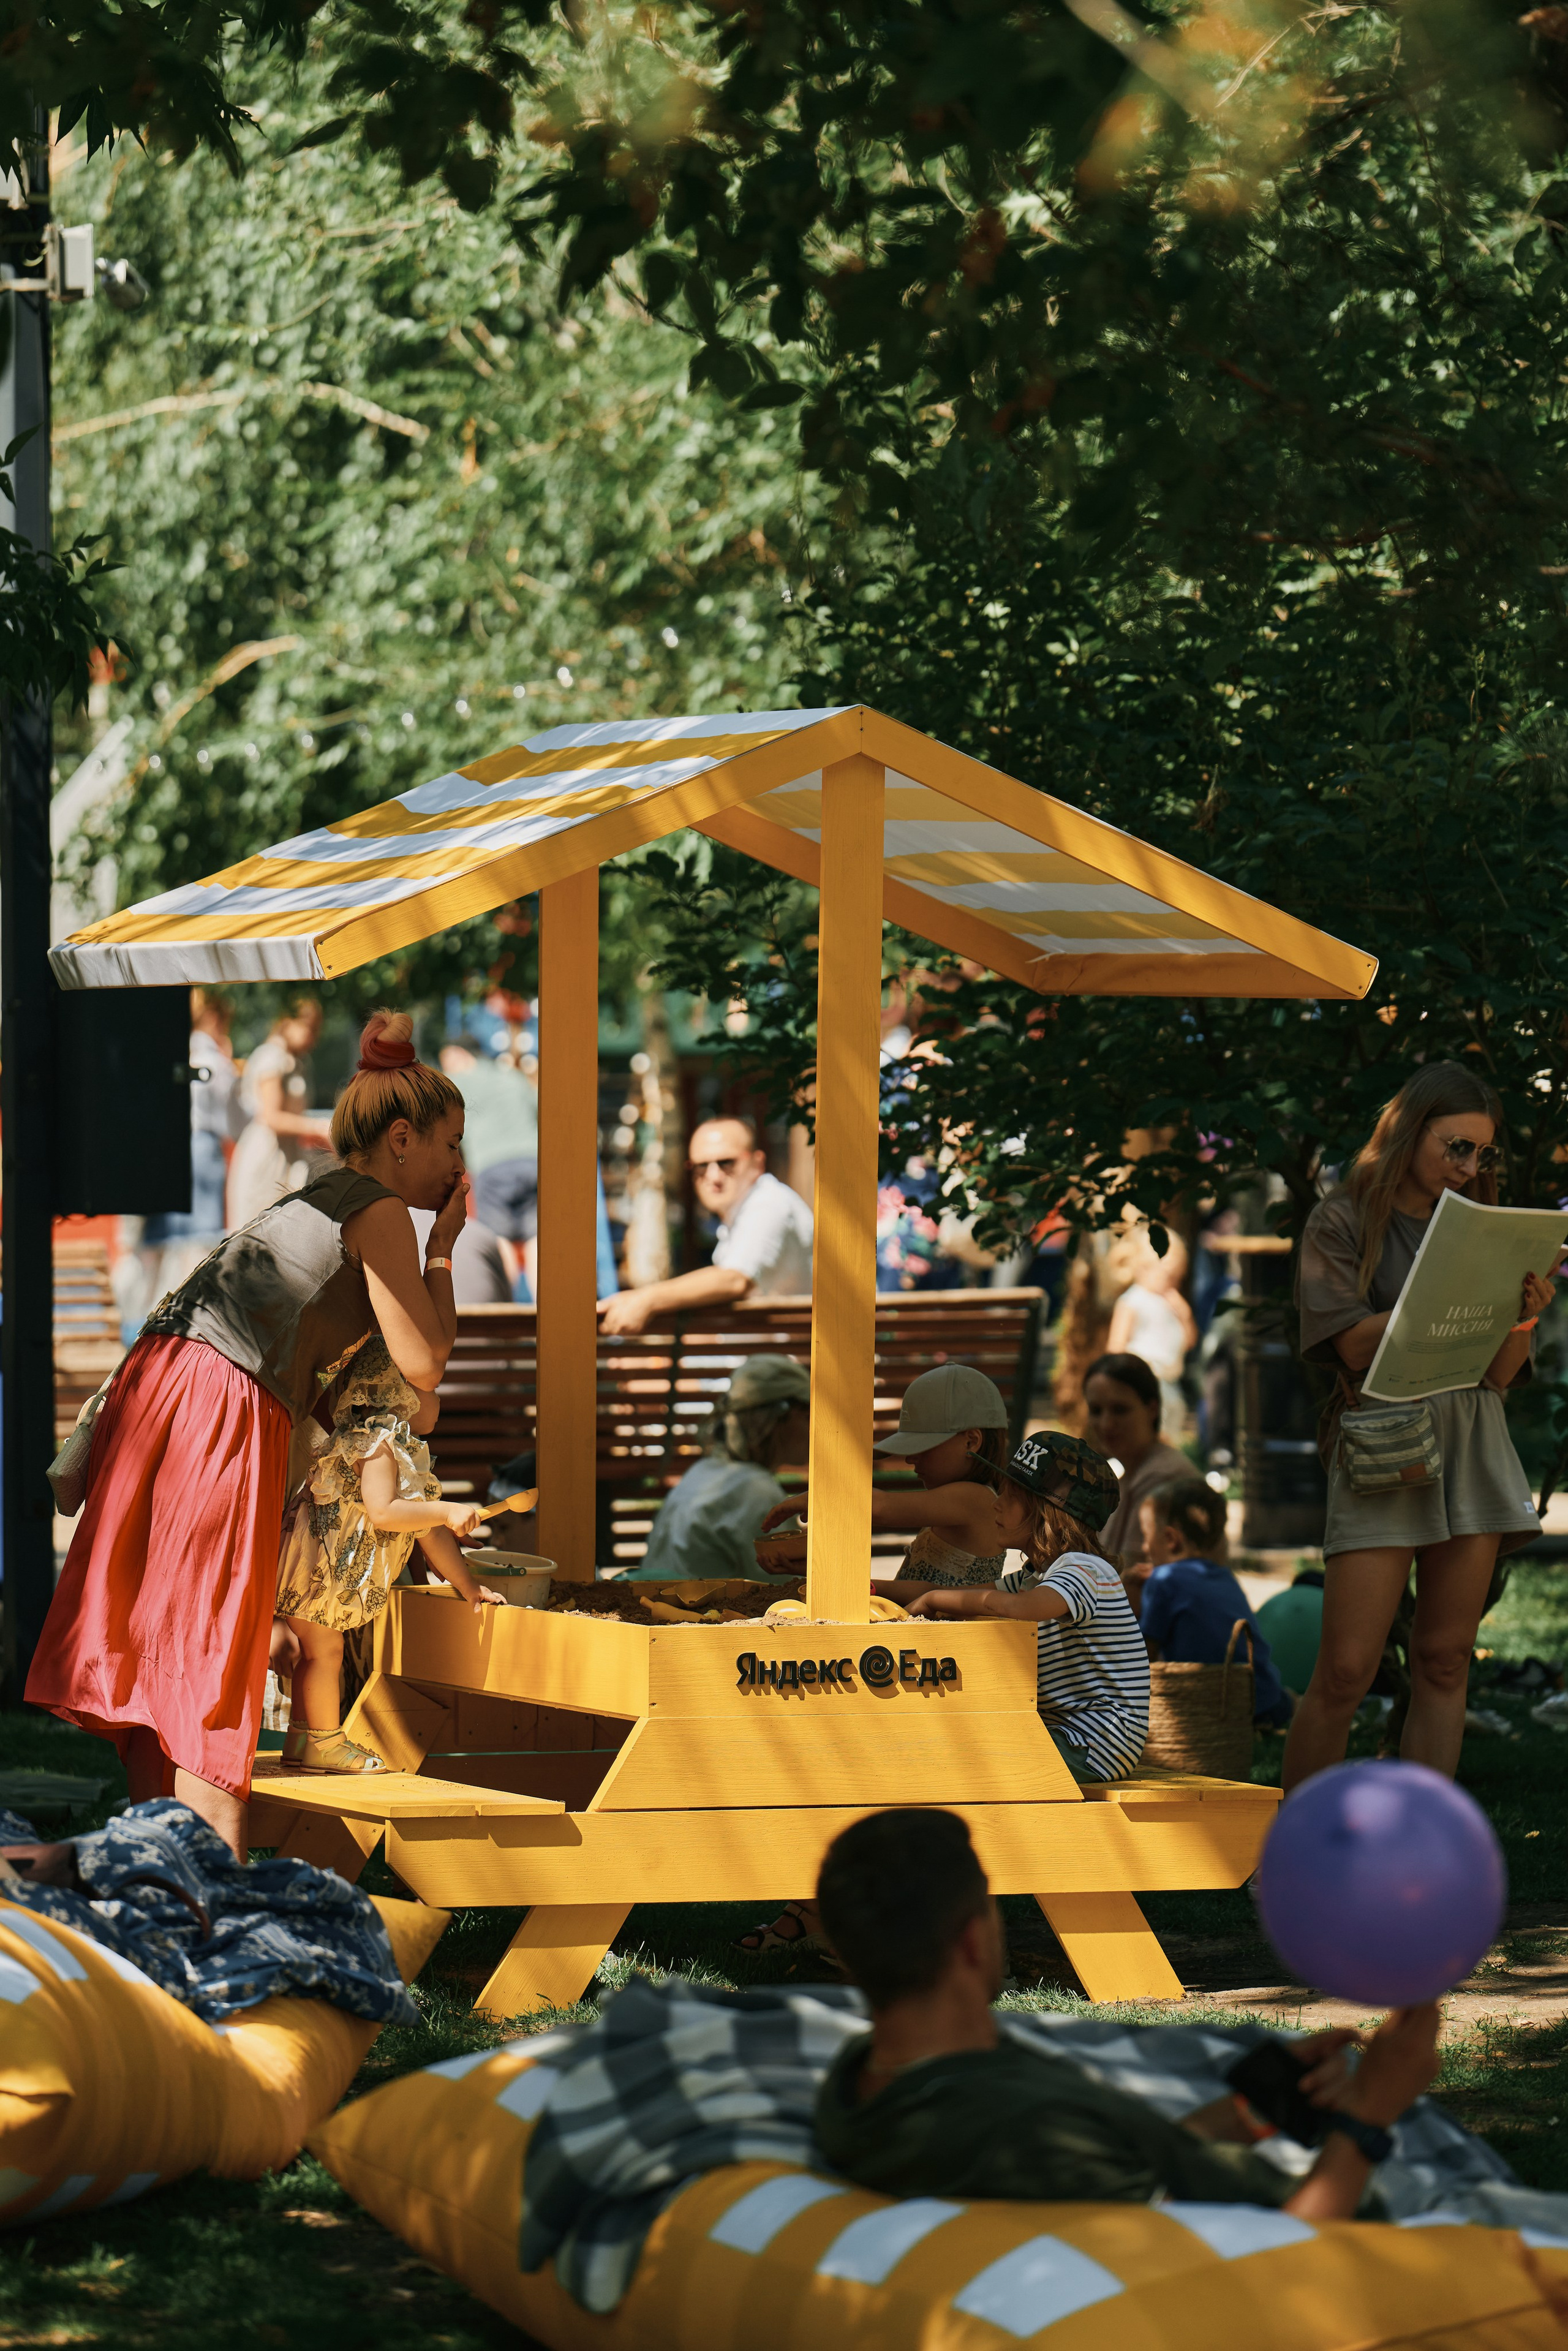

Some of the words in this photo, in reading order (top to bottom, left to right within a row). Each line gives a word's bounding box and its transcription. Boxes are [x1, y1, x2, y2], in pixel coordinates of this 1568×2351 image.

[1446, 1305, 1493, 1319] НАША
[1427, 1319, 1494, 1337] МИССИЯ
[1014, 1440, 1049, 1471] SK
[736, 1651, 853, 1689] Яндекс
[899, 1648, 957, 1686] Еда
